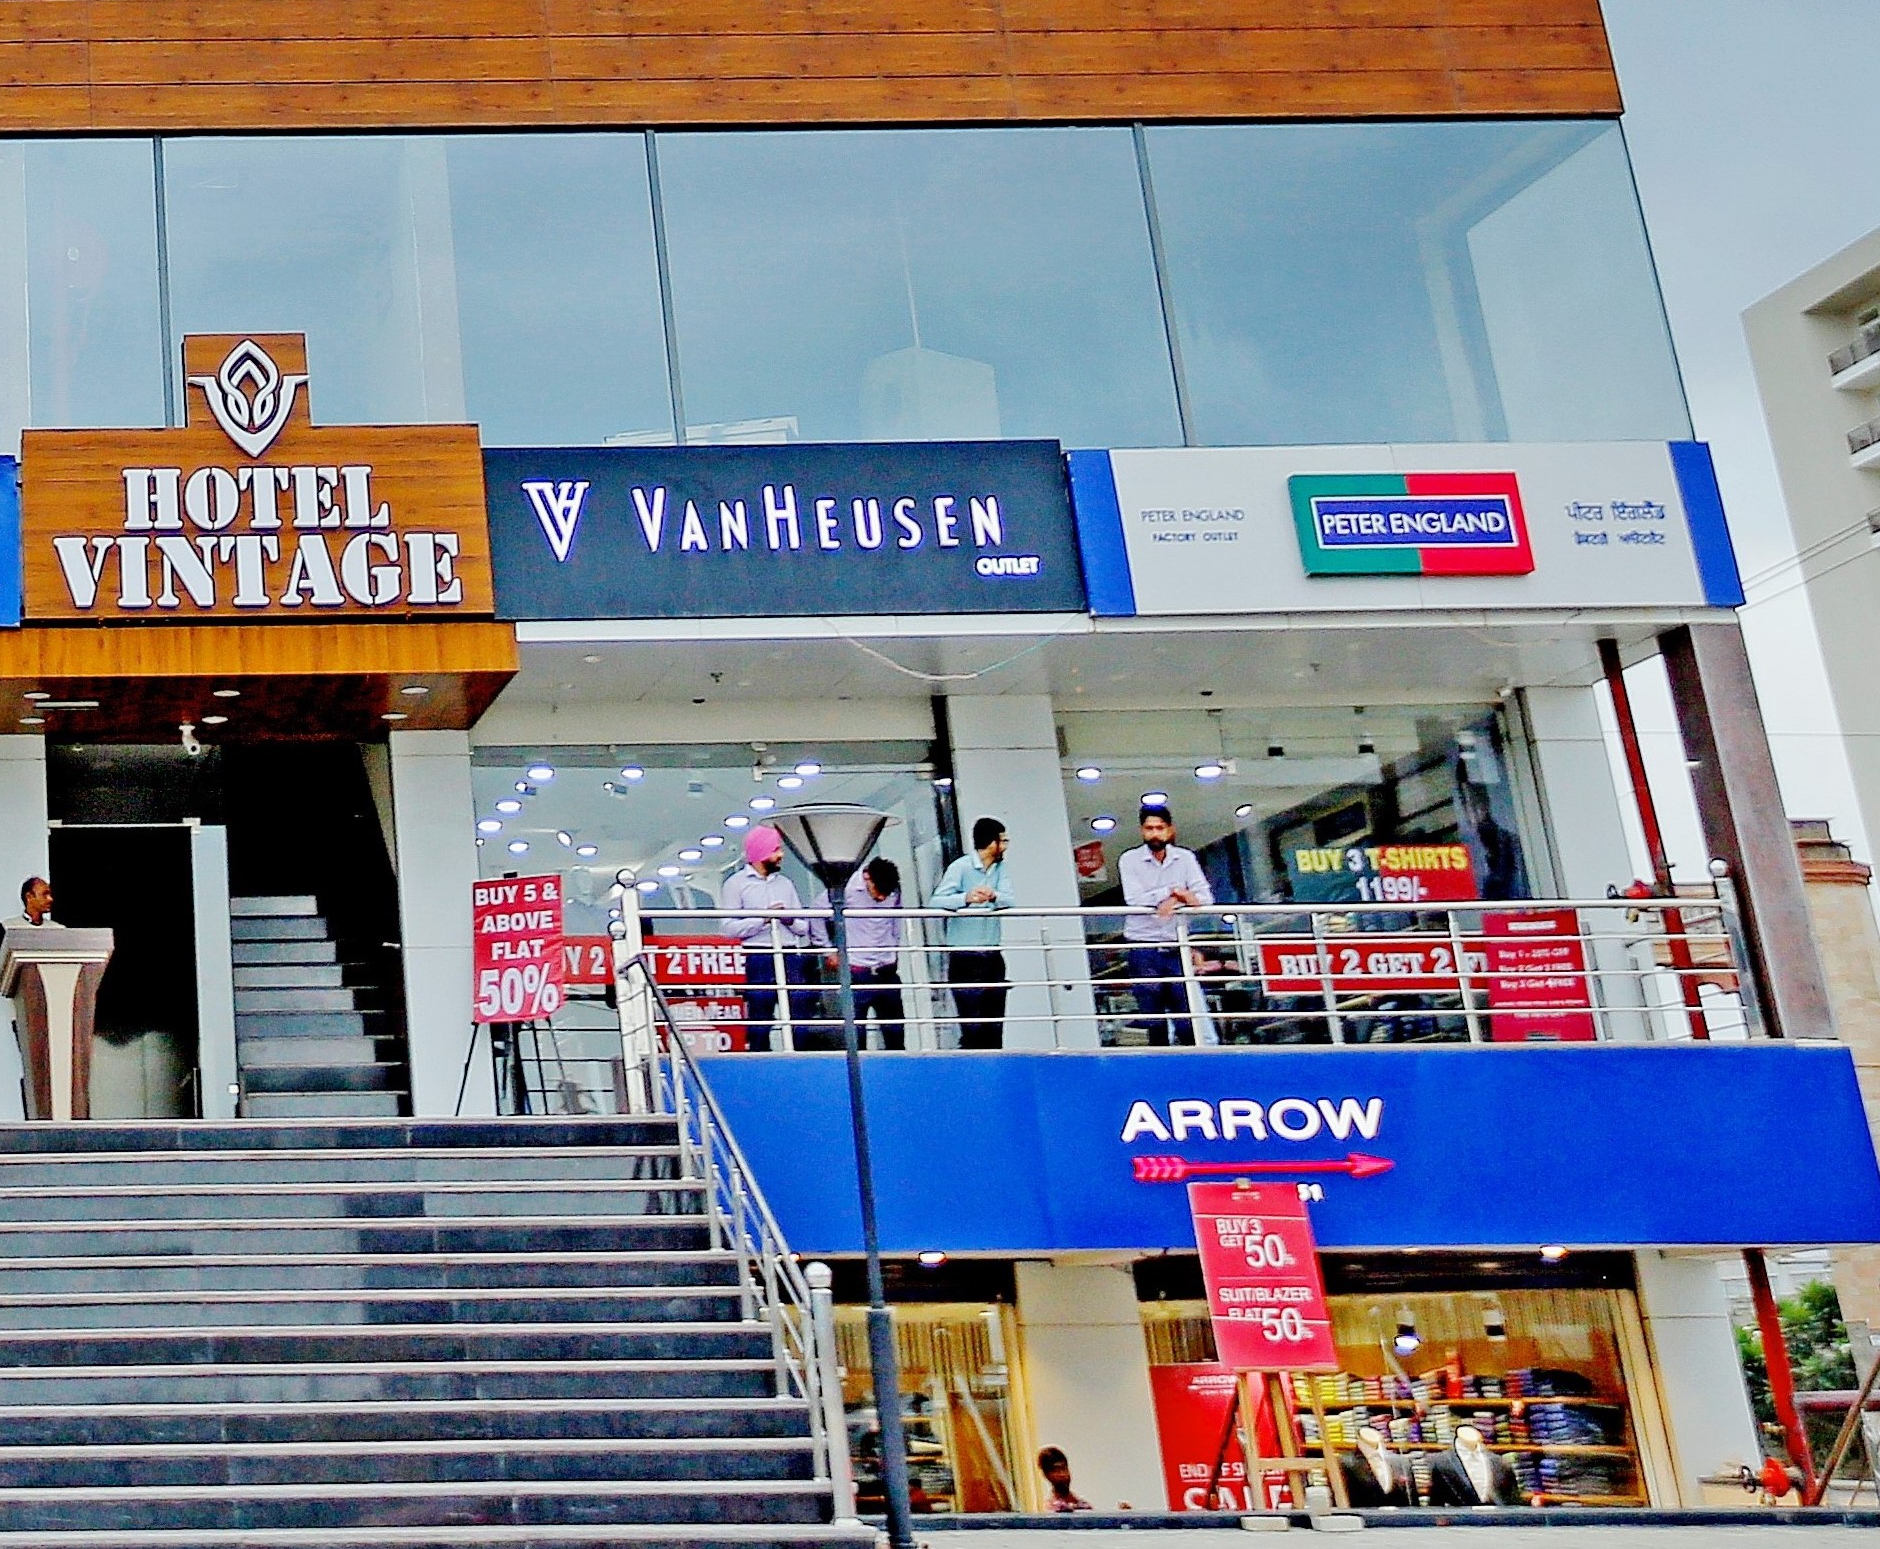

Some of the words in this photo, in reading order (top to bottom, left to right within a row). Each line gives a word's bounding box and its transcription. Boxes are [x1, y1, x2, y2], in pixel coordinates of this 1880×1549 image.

[122, 465, 390, 531] HOTEL
[1141, 510, 1176, 522] PETER
[1182, 509, 1245, 522] ENGLAND
[1321, 512, 1387, 536] PETER
[1390, 510, 1505, 535] ENGLAND
[53, 532, 464, 609] VINTAGE
[975, 555, 1040, 577] OUTLET
[1295, 849, 1342, 874] BUY
[1346, 849, 1364, 873] 3
[1367, 846, 1468, 872] T-SHIRTS
[475, 886, 518, 907] BUY
[523, 885, 537, 902] 5
[542, 884, 559, 901] &
[481, 910, 554, 934] ABOVE
[491, 939, 544, 961] FLAT
[590, 945, 607, 975] 2
[666, 946, 684, 975] 2
[687, 945, 747, 975] FREE
[1340, 948, 1364, 975] 2
[1367, 952, 1425, 974] GET
[1429, 947, 1455, 974] 2
[478, 962, 560, 1018] 50%
[1121, 1097, 1384, 1144] ARROW
[1215, 1218, 1247, 1235] BUY
[1247, 1218, 1263, 1235] 3
[1218, 1234, 1244, 1248] GET
